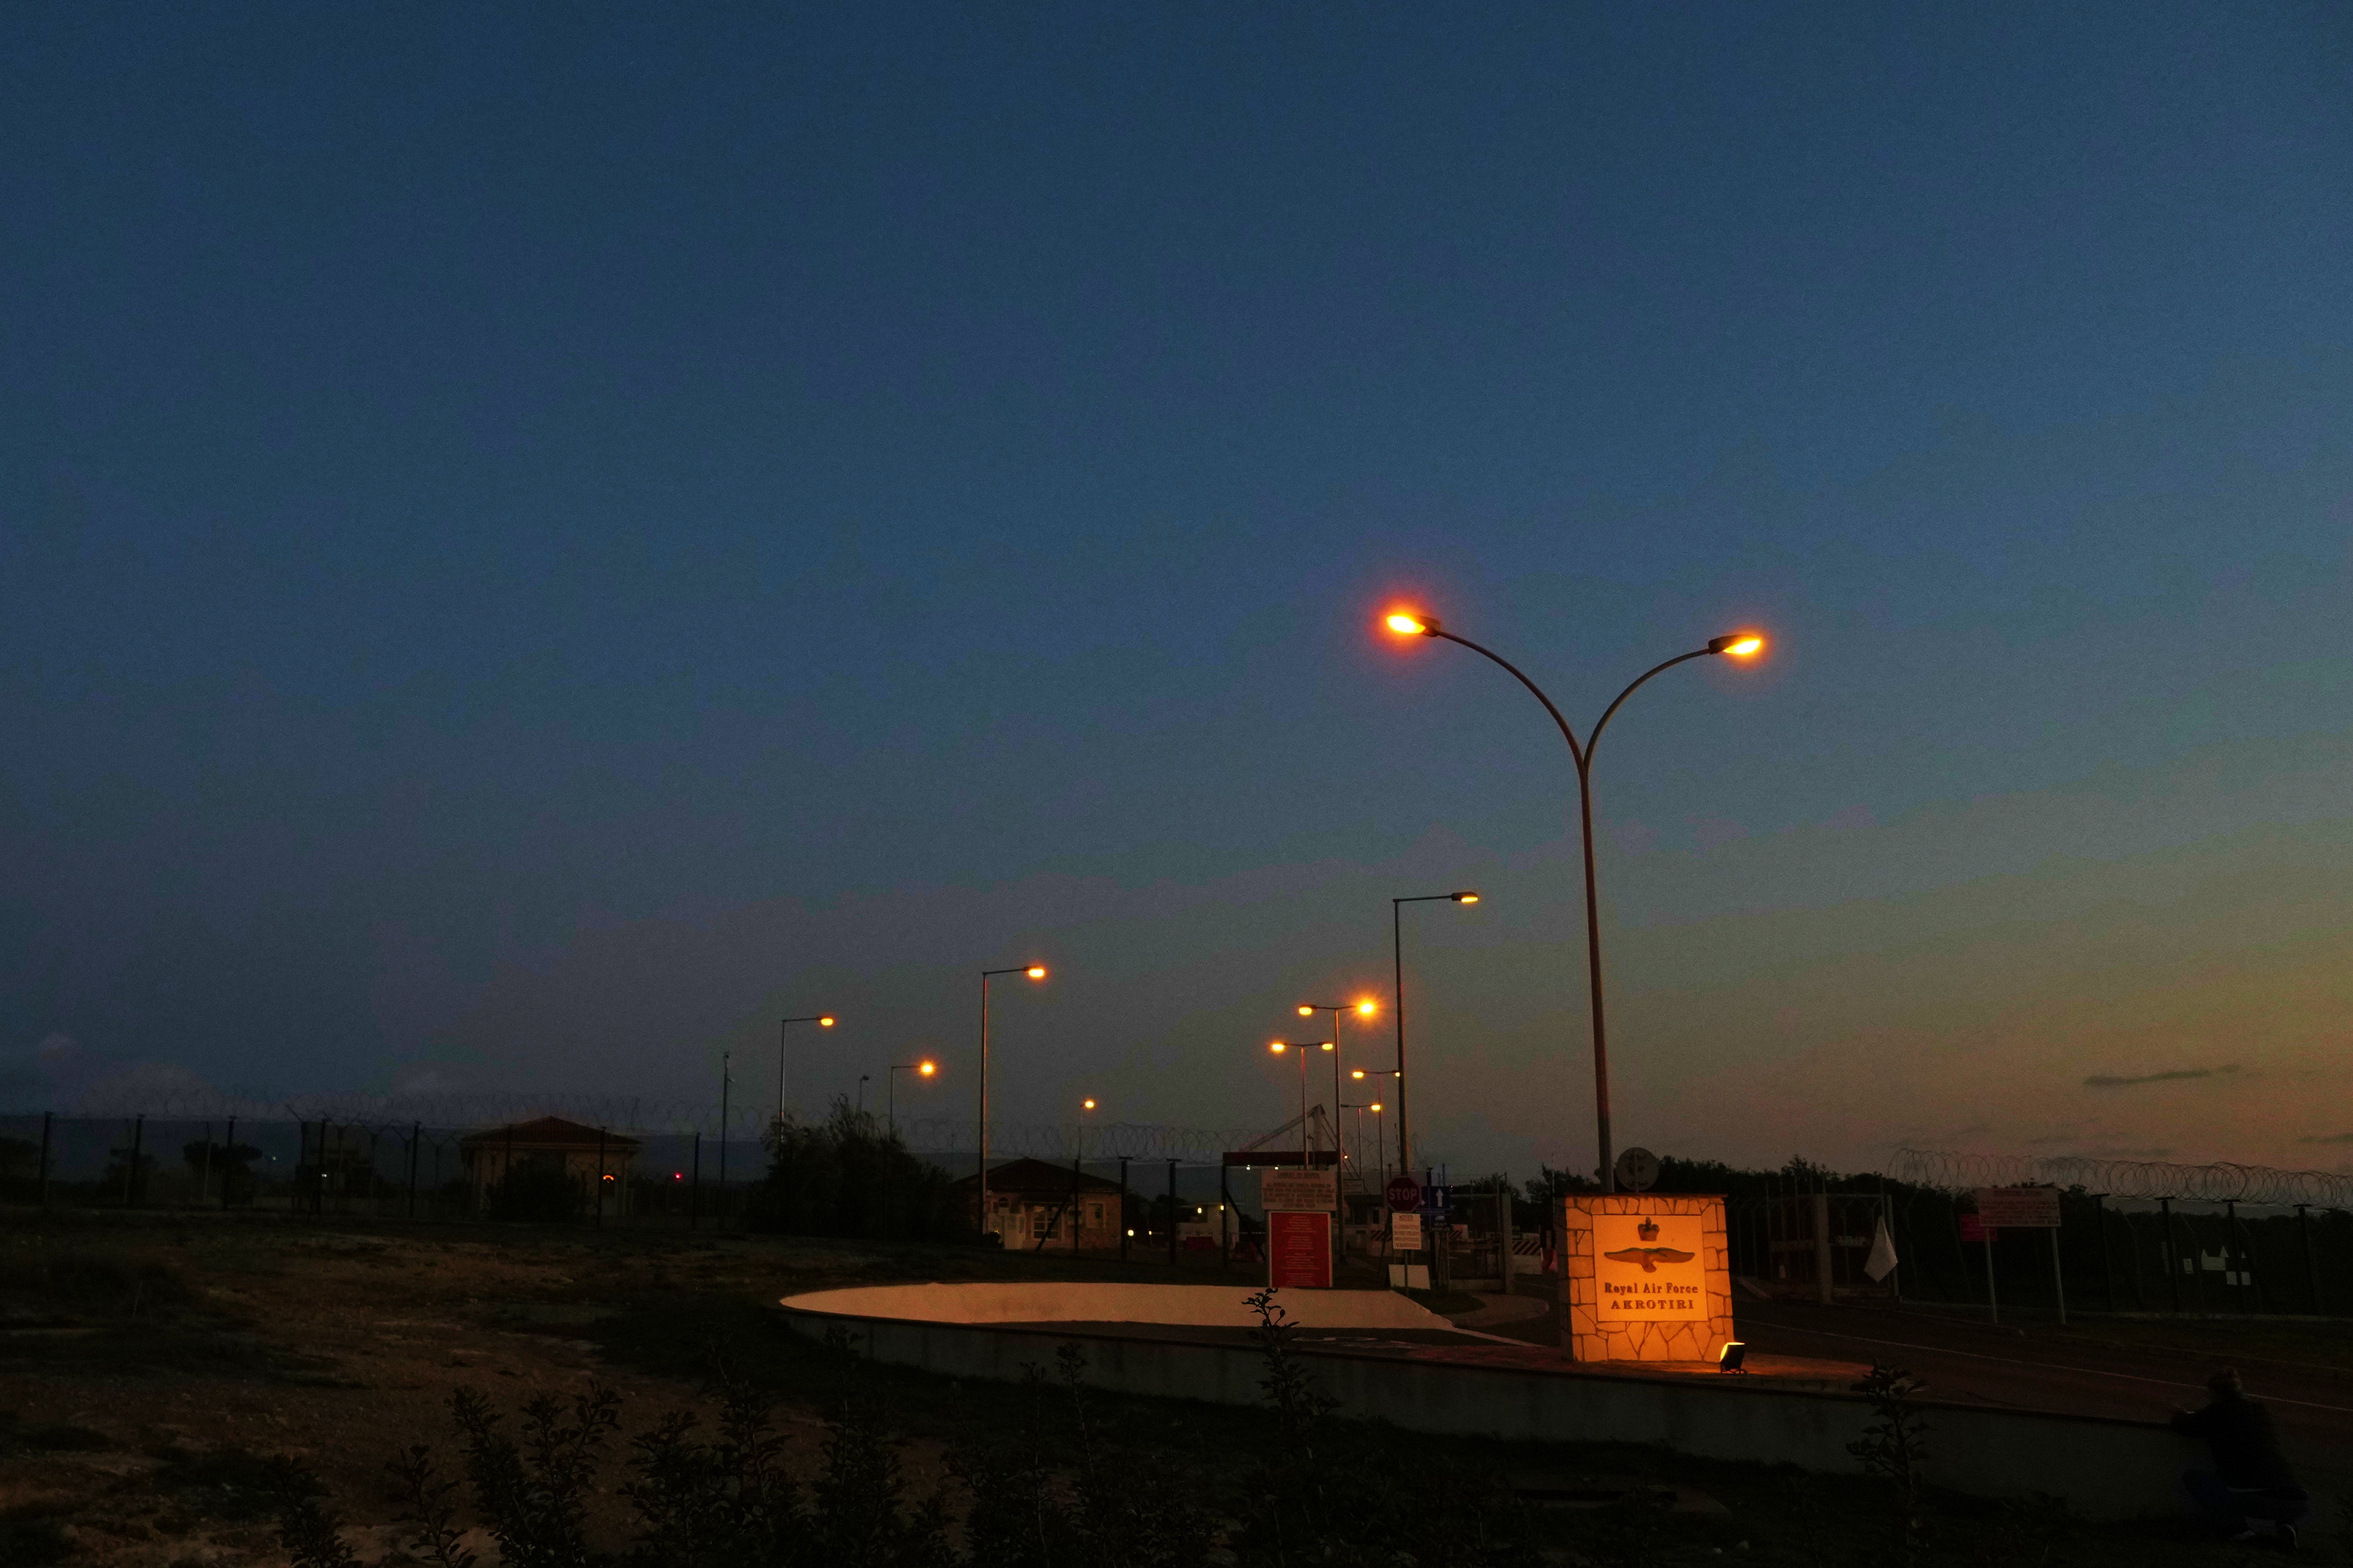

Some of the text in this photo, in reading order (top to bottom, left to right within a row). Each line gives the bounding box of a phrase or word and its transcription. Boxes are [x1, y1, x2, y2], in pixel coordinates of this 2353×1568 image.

[1389, 1188, 1417, 1200] STOP
[1604, 1282, 1698, 1296] Royal Air Force
[1611, 1300, 1694, 1309] AKROTIRI
